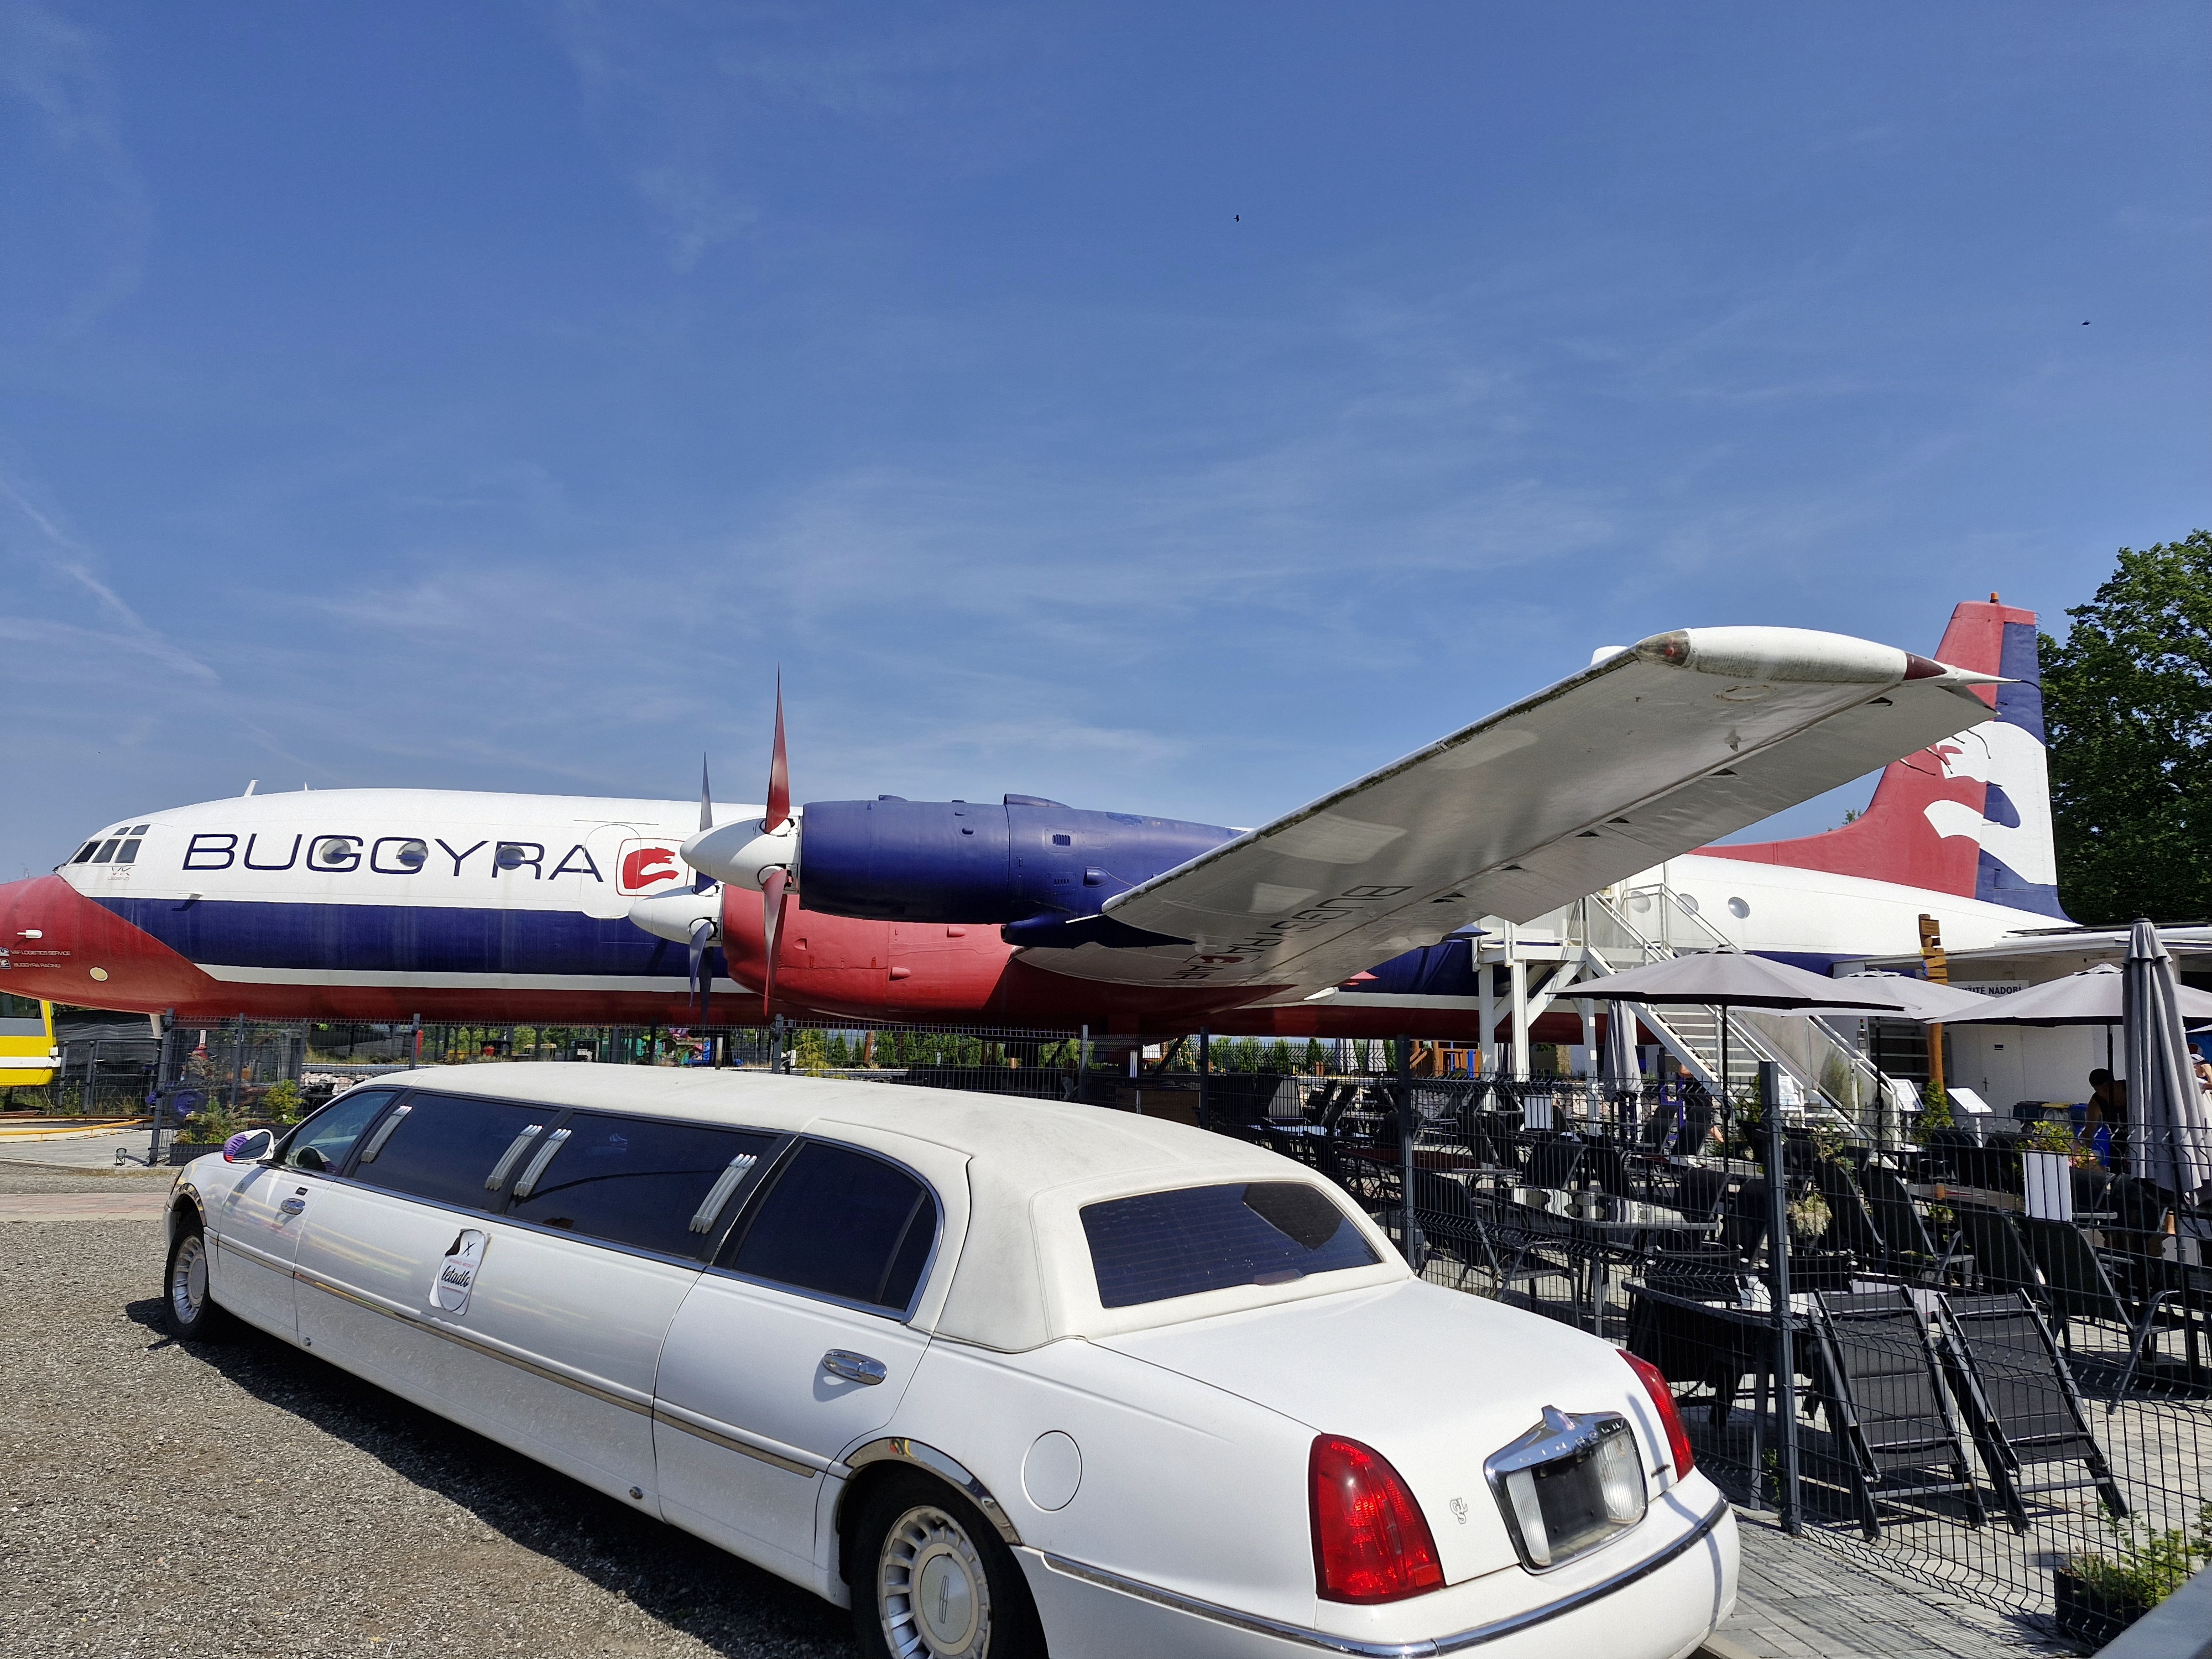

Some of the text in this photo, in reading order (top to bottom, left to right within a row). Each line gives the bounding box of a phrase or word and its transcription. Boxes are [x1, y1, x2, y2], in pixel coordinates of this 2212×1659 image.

[182, 833, 603, 883] BUGGYRA
[1215, 885, 1414, 954] BUGGYRA
[441, 1265, 471, 1287] letadlo
[1519, 1422, 1621, 1463] LINCOLN
